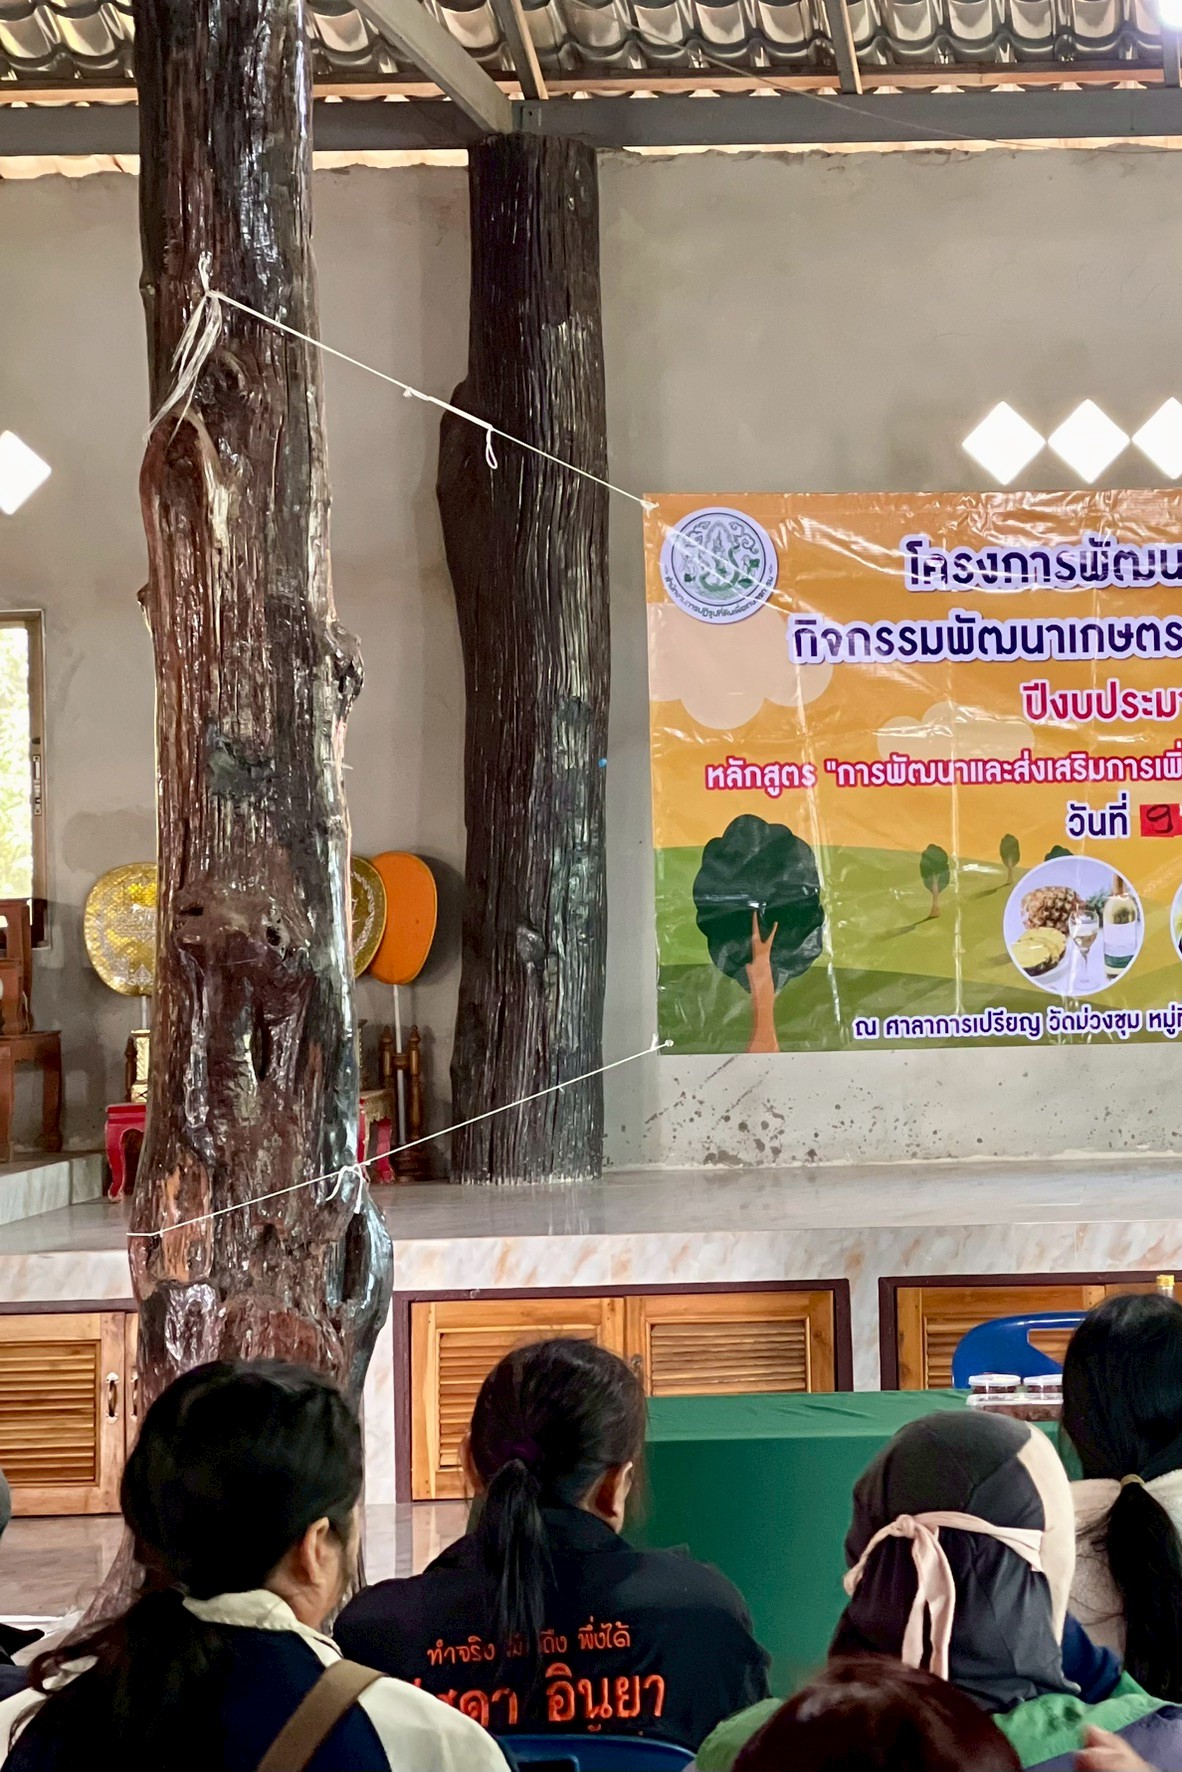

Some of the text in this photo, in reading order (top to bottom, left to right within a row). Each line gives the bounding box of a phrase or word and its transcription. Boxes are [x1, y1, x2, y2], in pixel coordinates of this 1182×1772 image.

[708, 757, 816, 795] หลักสูตร
[1068, 793, 1128, 836] วันที่
[855, 1021, 877, 1037] ณ
[886, 1011, 1041, 1040] ศาลาการเปรียญ
[1049, 1008, 1138, 1038] วัดม่วงชุม
[427, 1635, 496, 1666] ทำจริง
[578, 1616, 631, 1651] พึ่งได้
